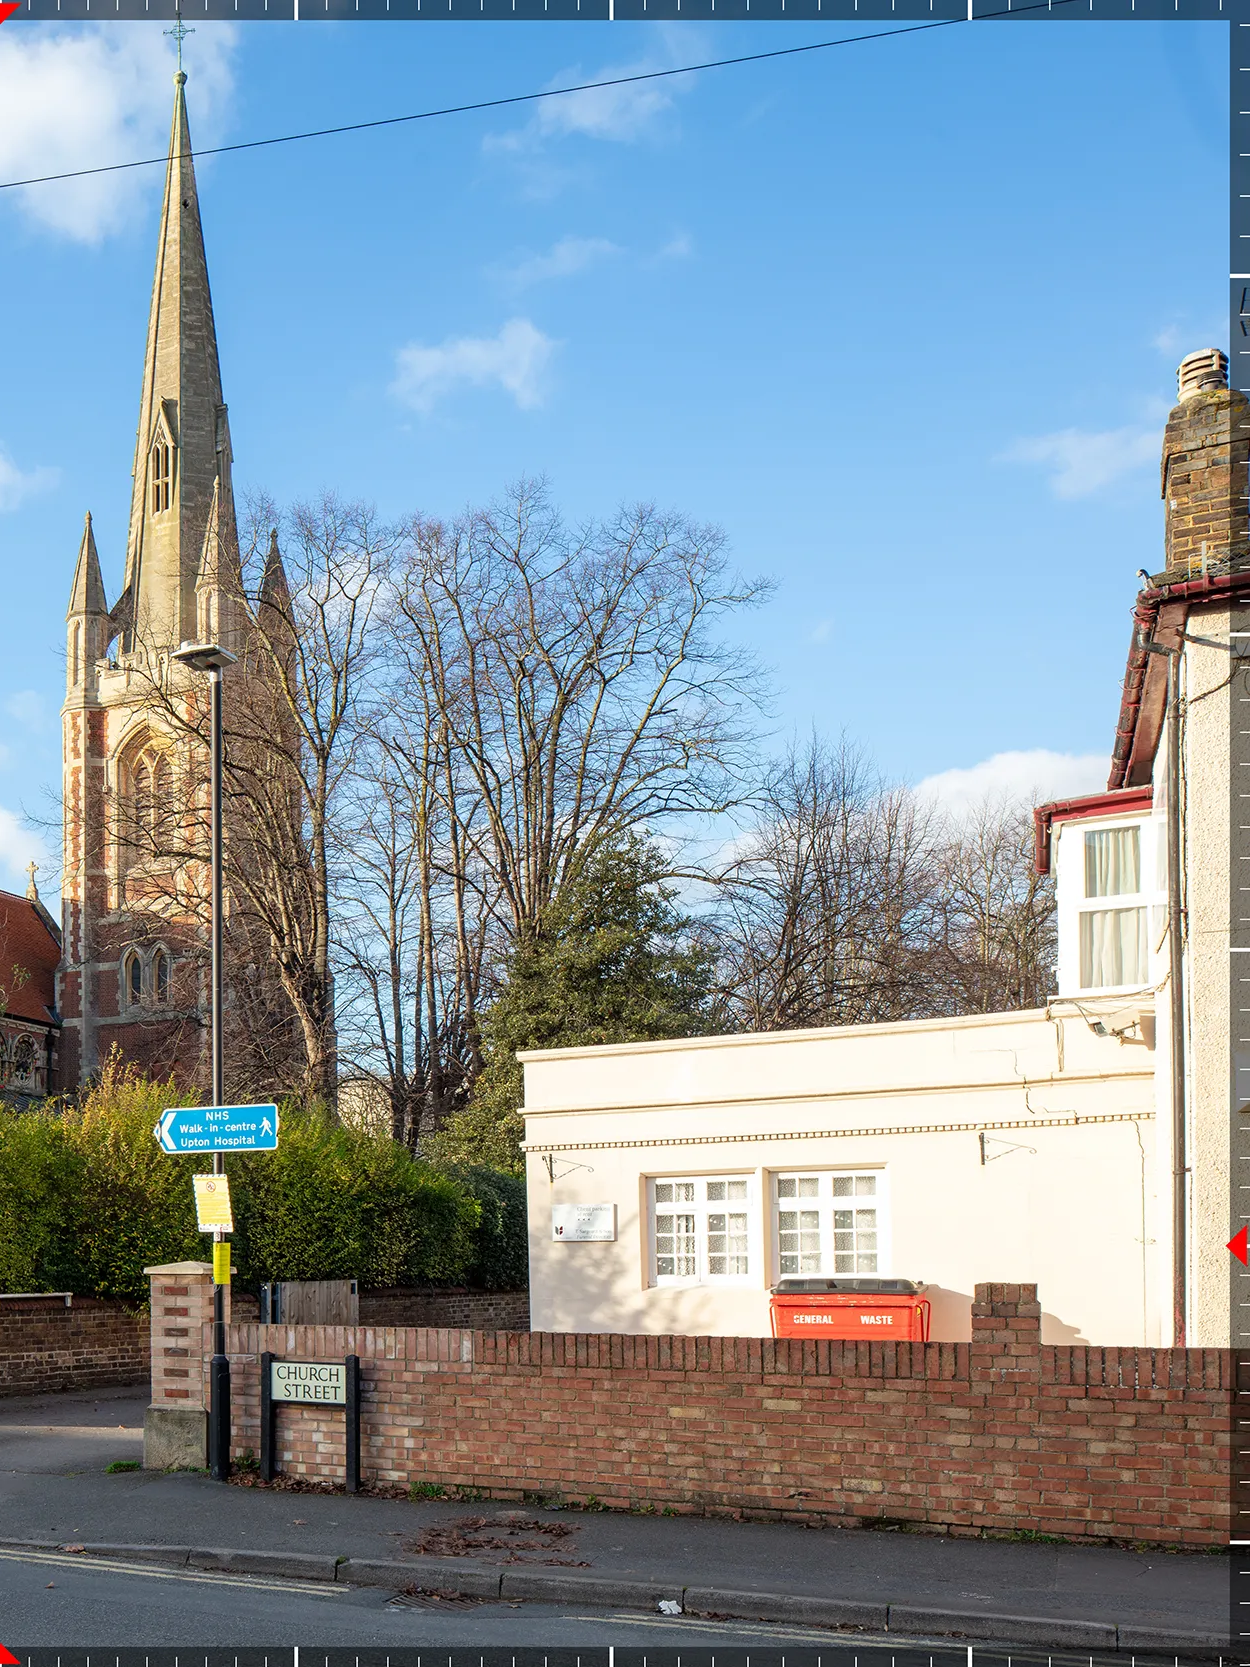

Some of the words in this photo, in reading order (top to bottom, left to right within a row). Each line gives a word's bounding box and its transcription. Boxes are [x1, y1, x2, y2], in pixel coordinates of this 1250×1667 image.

[205, 1111, 229, 1121] NHS
[180, 1137, 210, 1148] Upton
[214, 1135, 256, 1147] Hospital
[793, 1314, 834, 1325] GENERAL
[860, 1315, 893, 1325] WASTE
[276, 1365, 339, 1382] CHURCH
[283, 1383, 341, 1400] STREET
